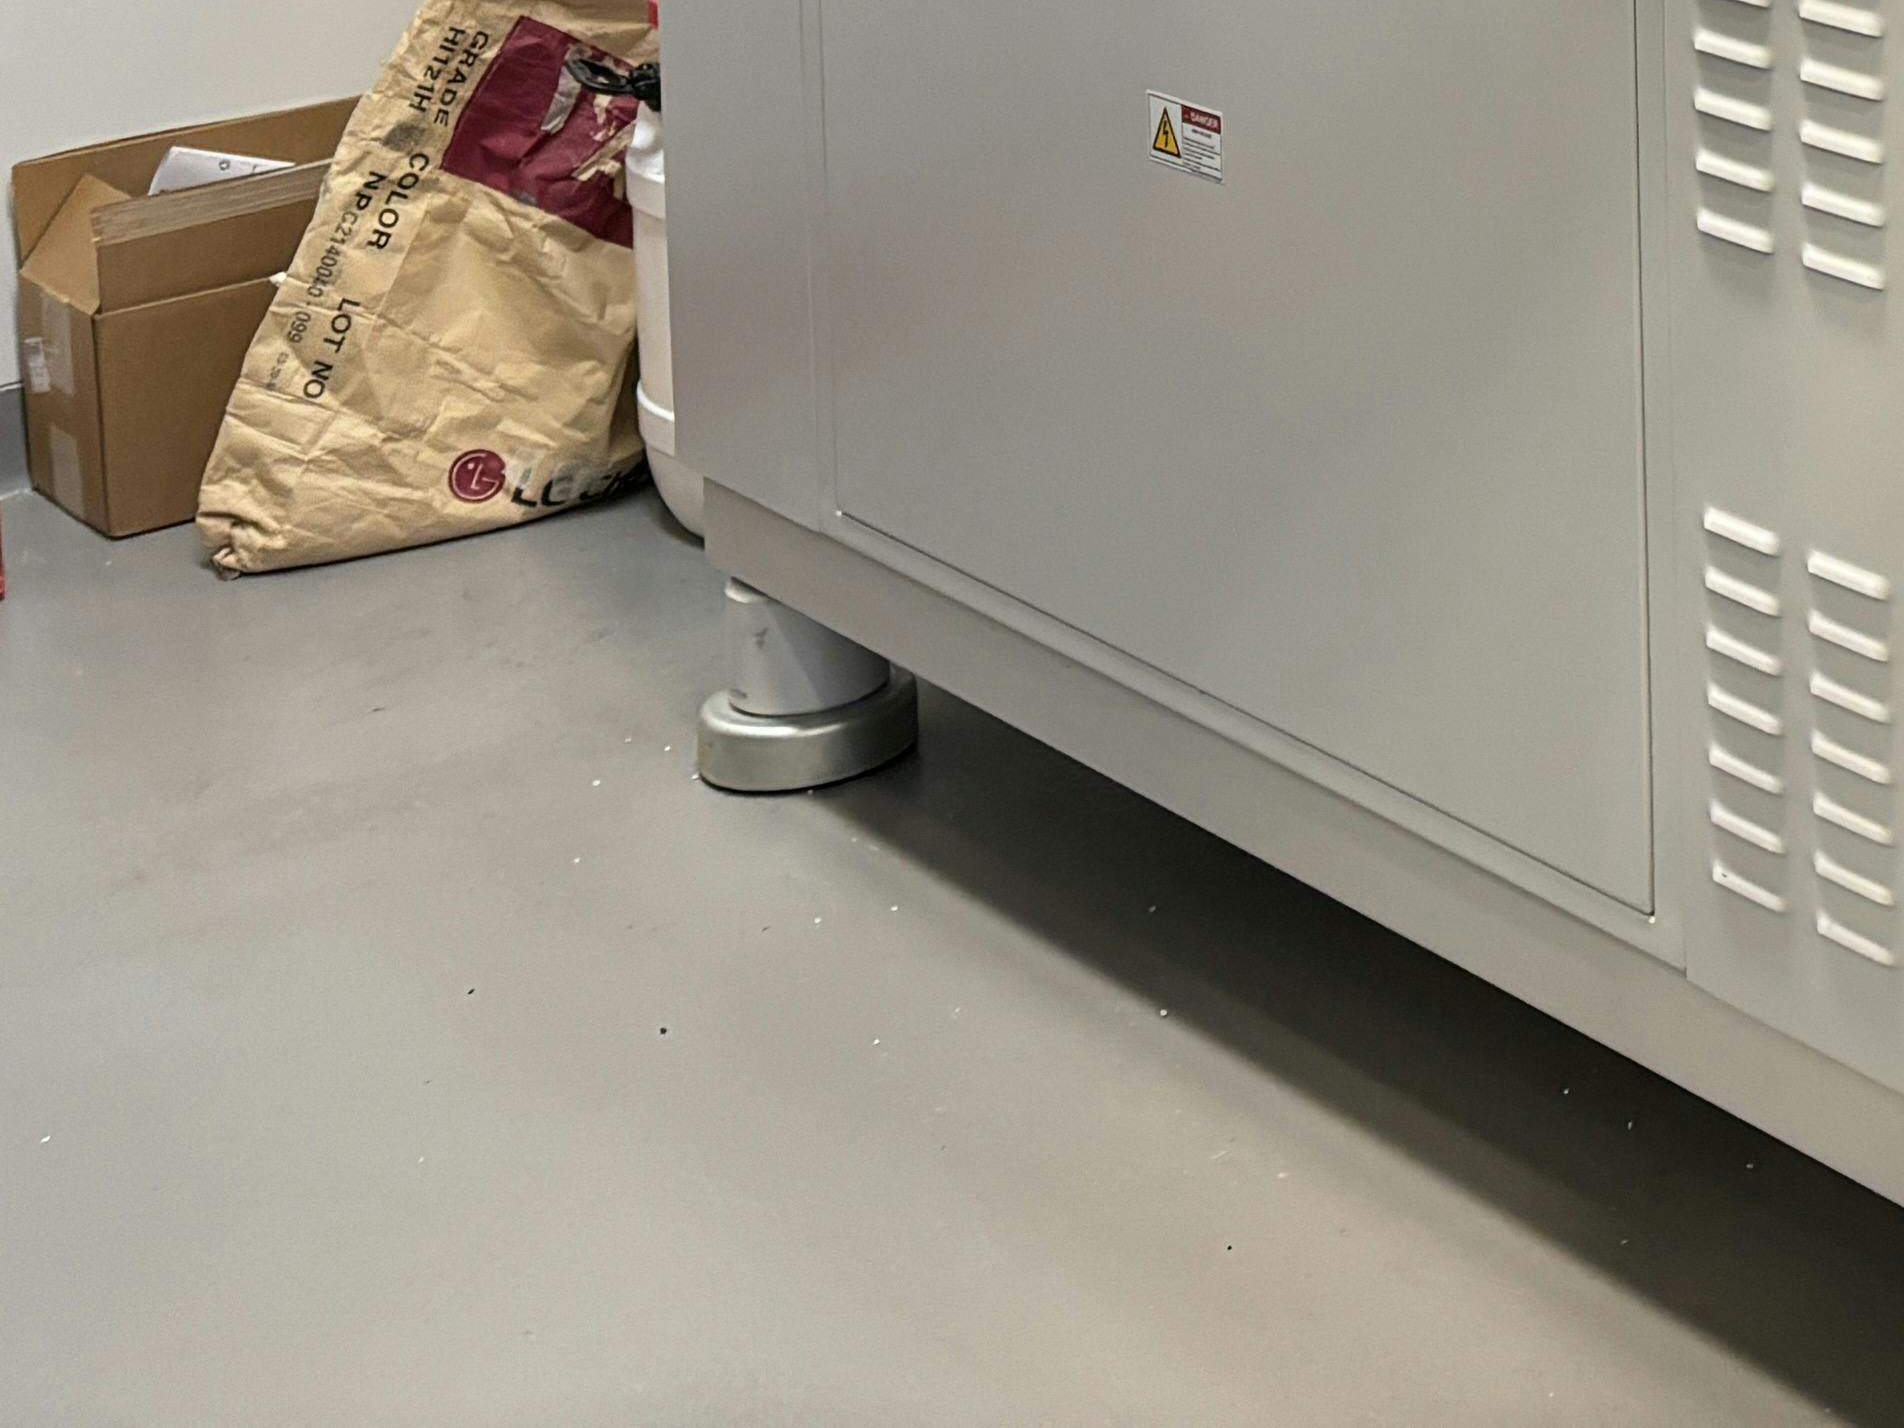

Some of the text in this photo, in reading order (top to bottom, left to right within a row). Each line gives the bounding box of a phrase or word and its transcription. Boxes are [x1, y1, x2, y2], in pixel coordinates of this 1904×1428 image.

[409, 27, 466, 113] HI121H
[434, 31, 489, 127] GRADE
[367, 152, 430, 250] COLOR
[303, 297, 361, 399] LOT NO
